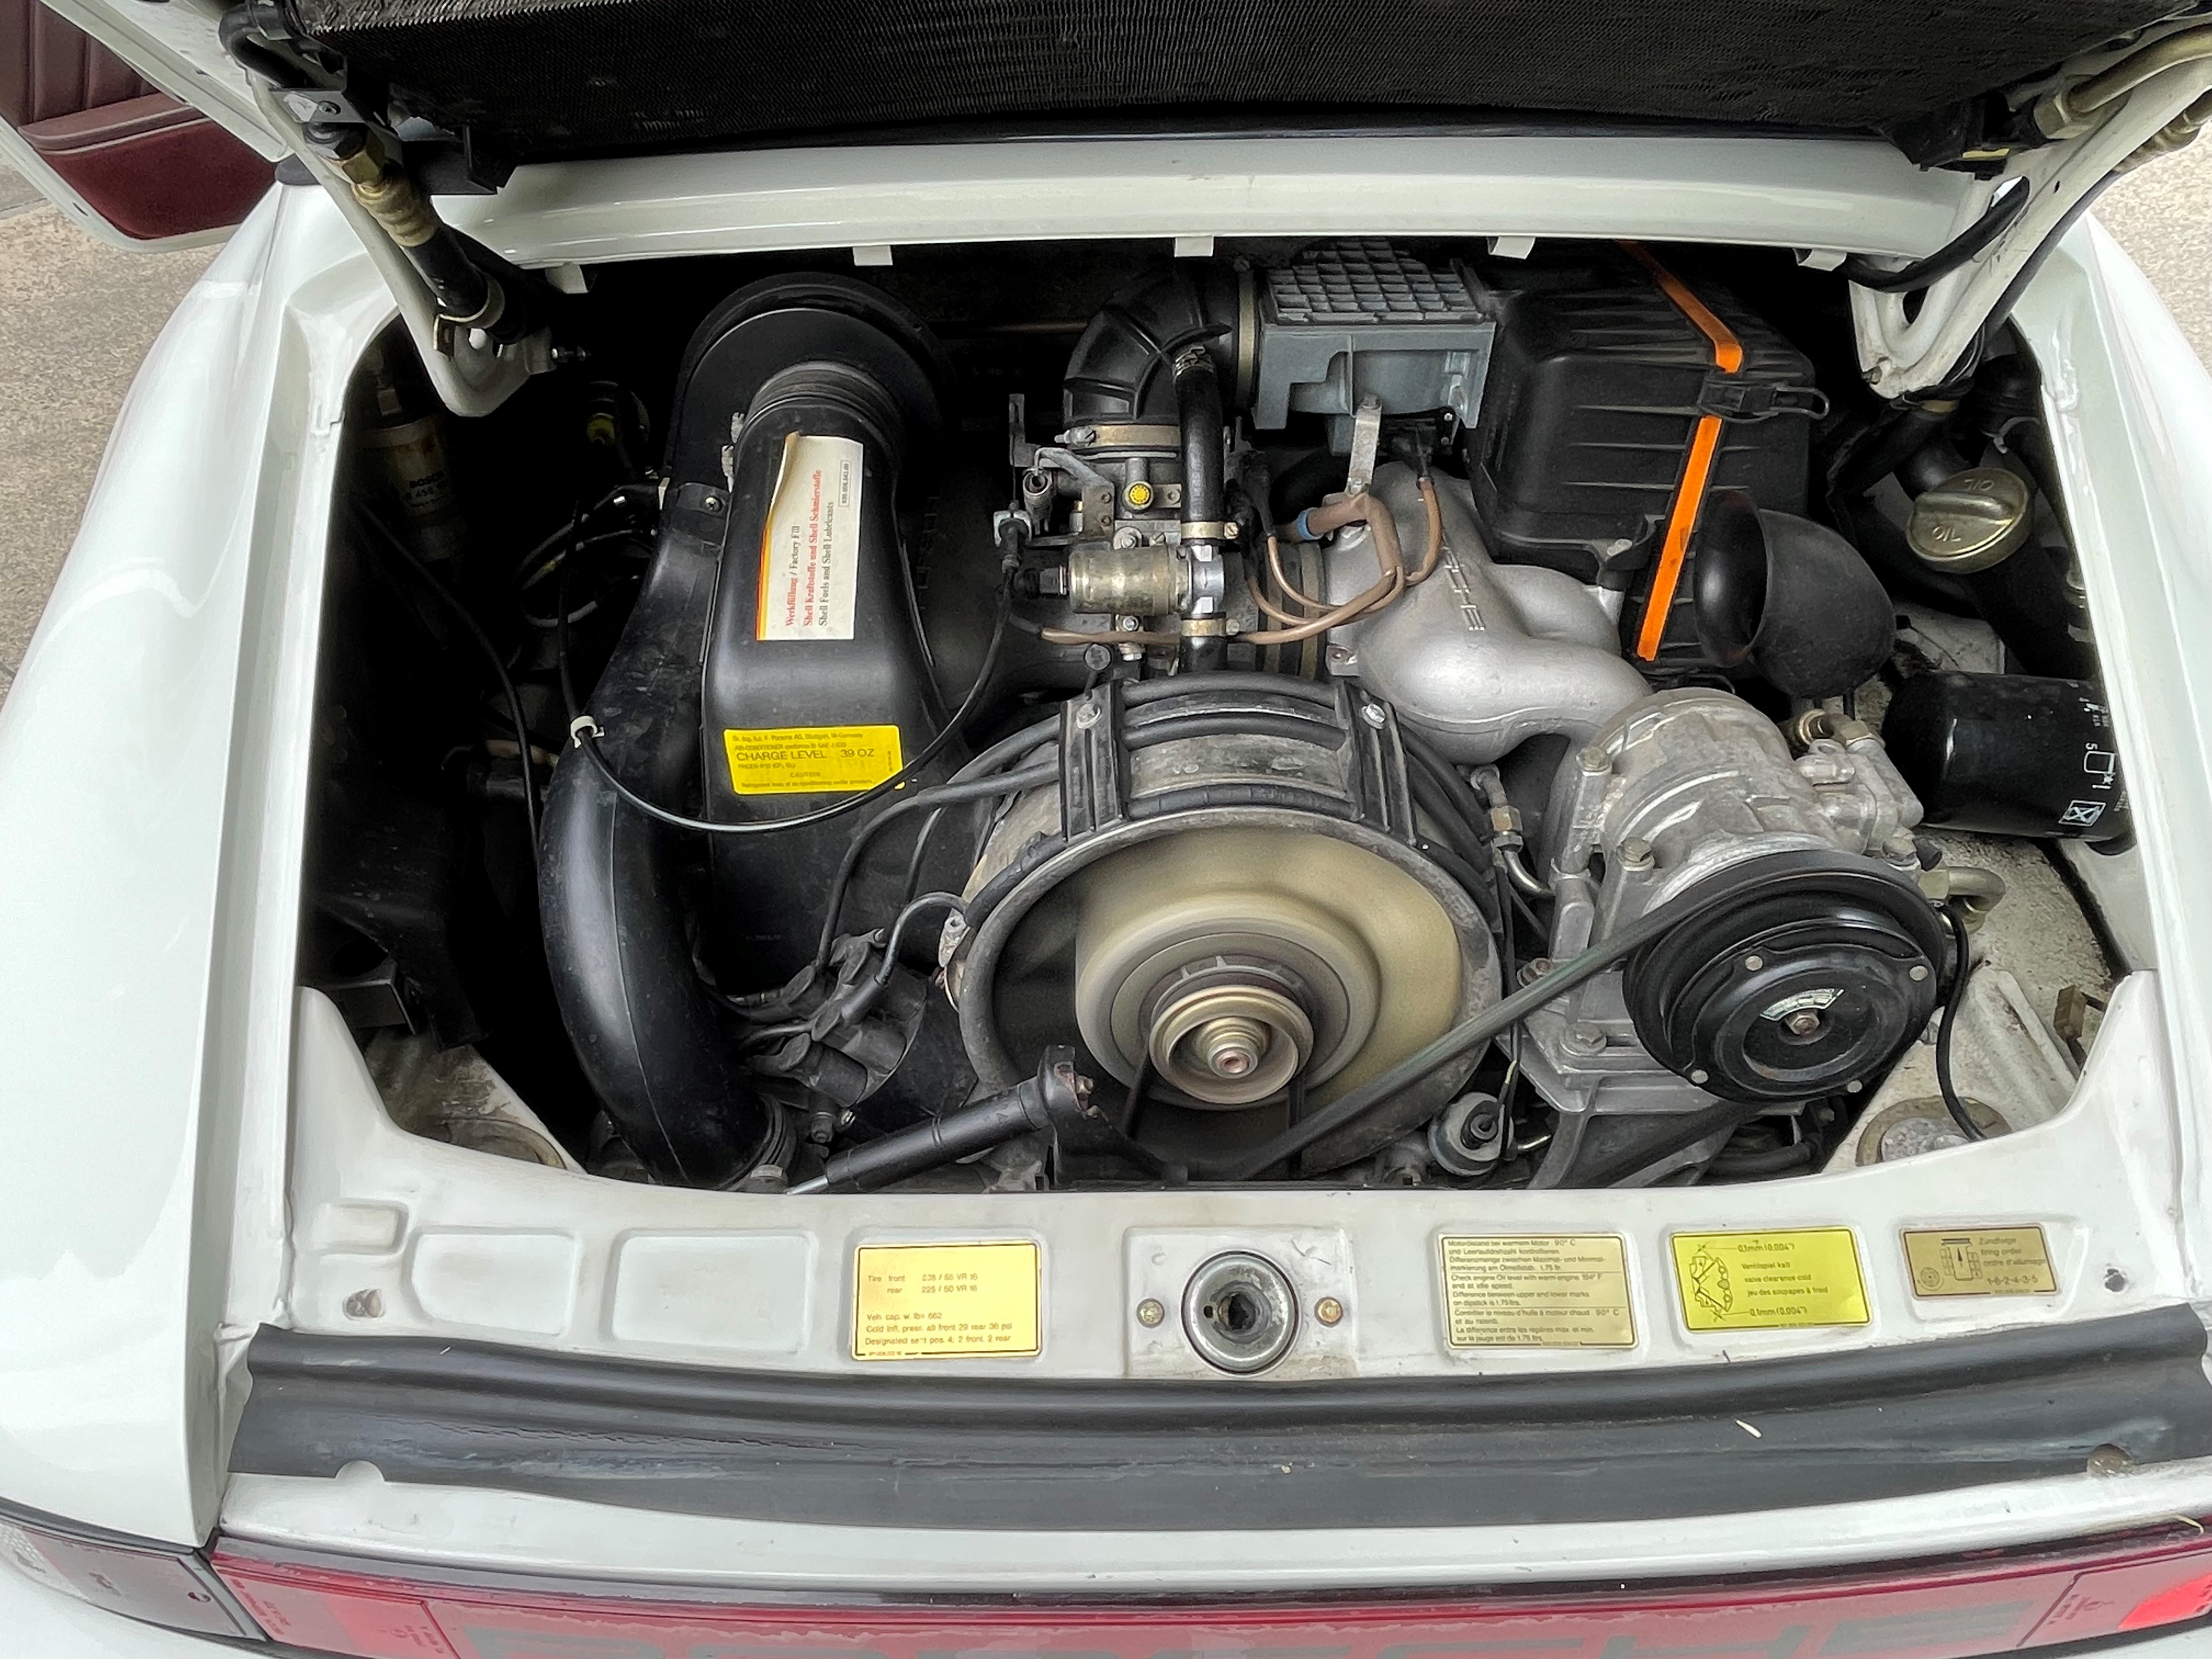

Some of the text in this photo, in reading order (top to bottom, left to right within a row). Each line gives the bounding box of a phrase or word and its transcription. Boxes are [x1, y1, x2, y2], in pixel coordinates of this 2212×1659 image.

[1965, 479, 1994, 491] OIL
[791, 526, 800, 539] Fill
[1932, 526, 1961, 542] OIL
[803, 470, 822, 626] Shell Kraftstoffe und Shell Schmierstoffe
[789, 542, 801, 569] Factory
[819, 501, 834, 626] Shell Fuels and Shell Lubricants
[736, 748, 874, 761] CHARGE LEVEL 39 OZ
[867, 1274, 882, 1283] Tire
[888, 1274, 905, 1282] front
[922, 1285, 936, 1294] 225
[1001, 1322, 1012, 1330] psi
[865, 1338, 907, 1346] Designated
